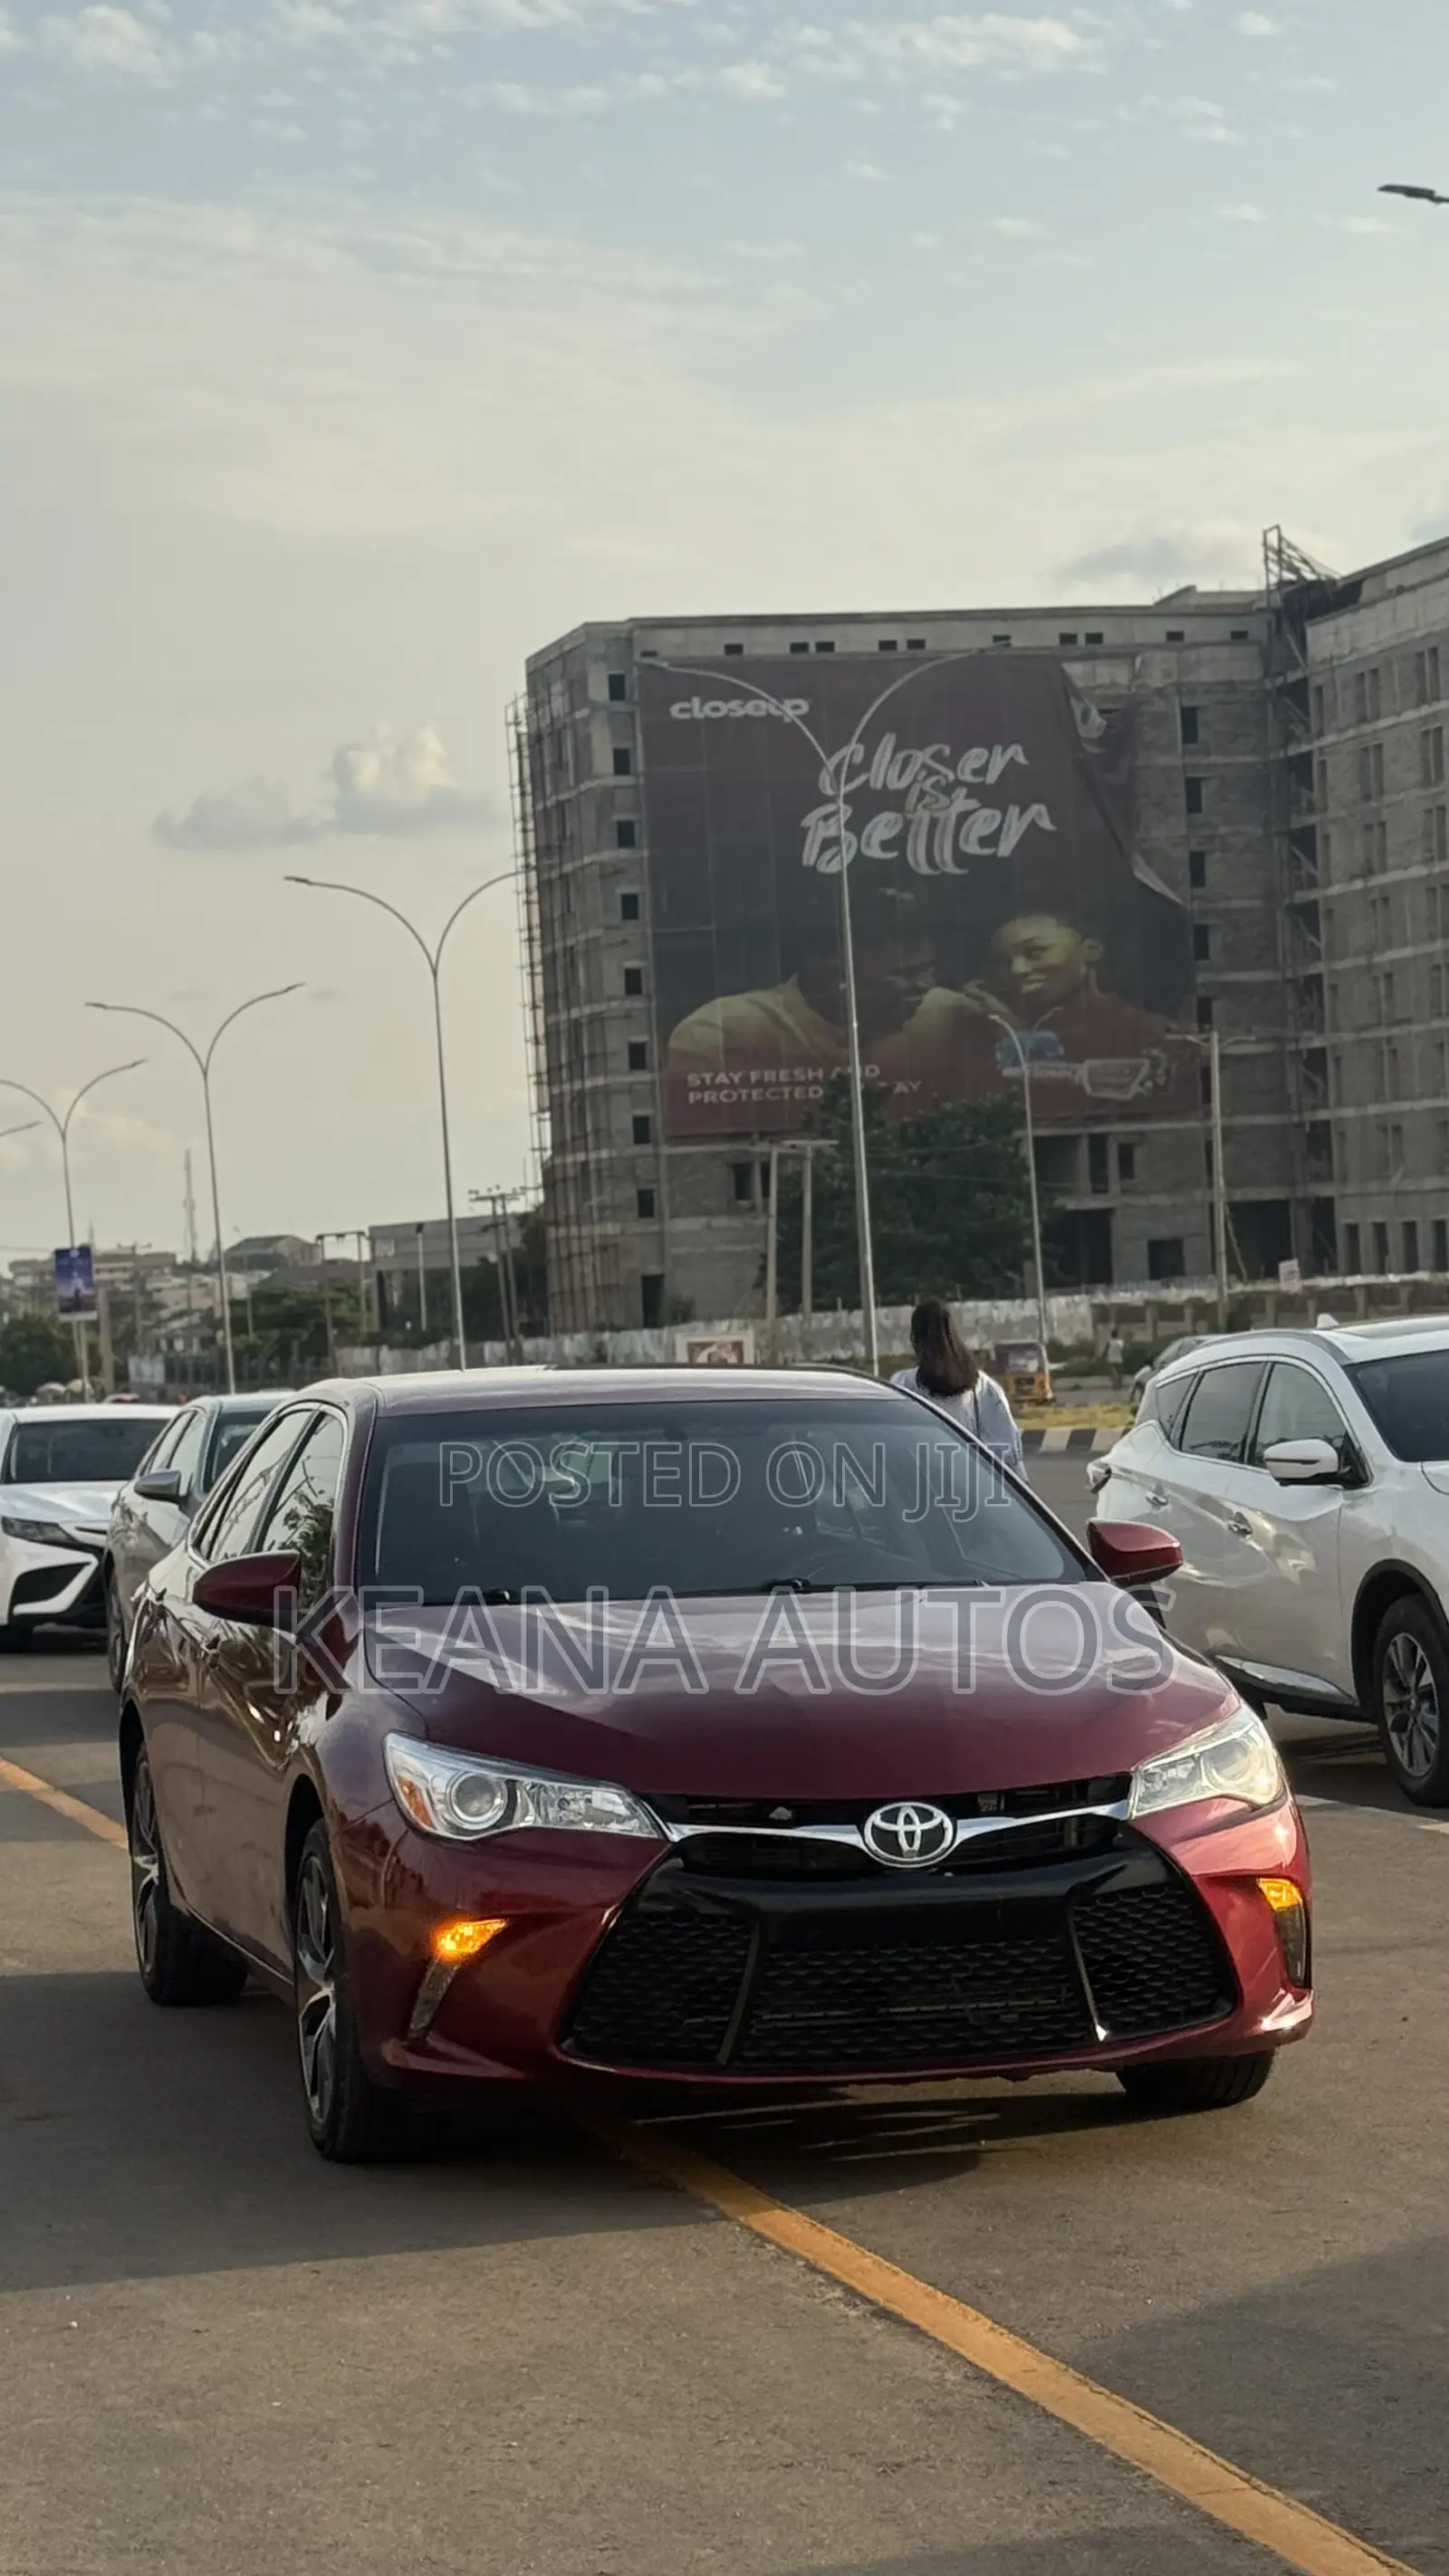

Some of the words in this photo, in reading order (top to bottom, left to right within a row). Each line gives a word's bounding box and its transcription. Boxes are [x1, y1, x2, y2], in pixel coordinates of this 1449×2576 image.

[819, 732, 1030, 797] Closer
[906, 771, 952, 813] is
[801, 786, 1058, 876] Better
[686, 1071, 743, 1087] STAY
[750, 1067, 824, 1084] FRESH
[687, 1086, 825, 1104] PROTECTED
